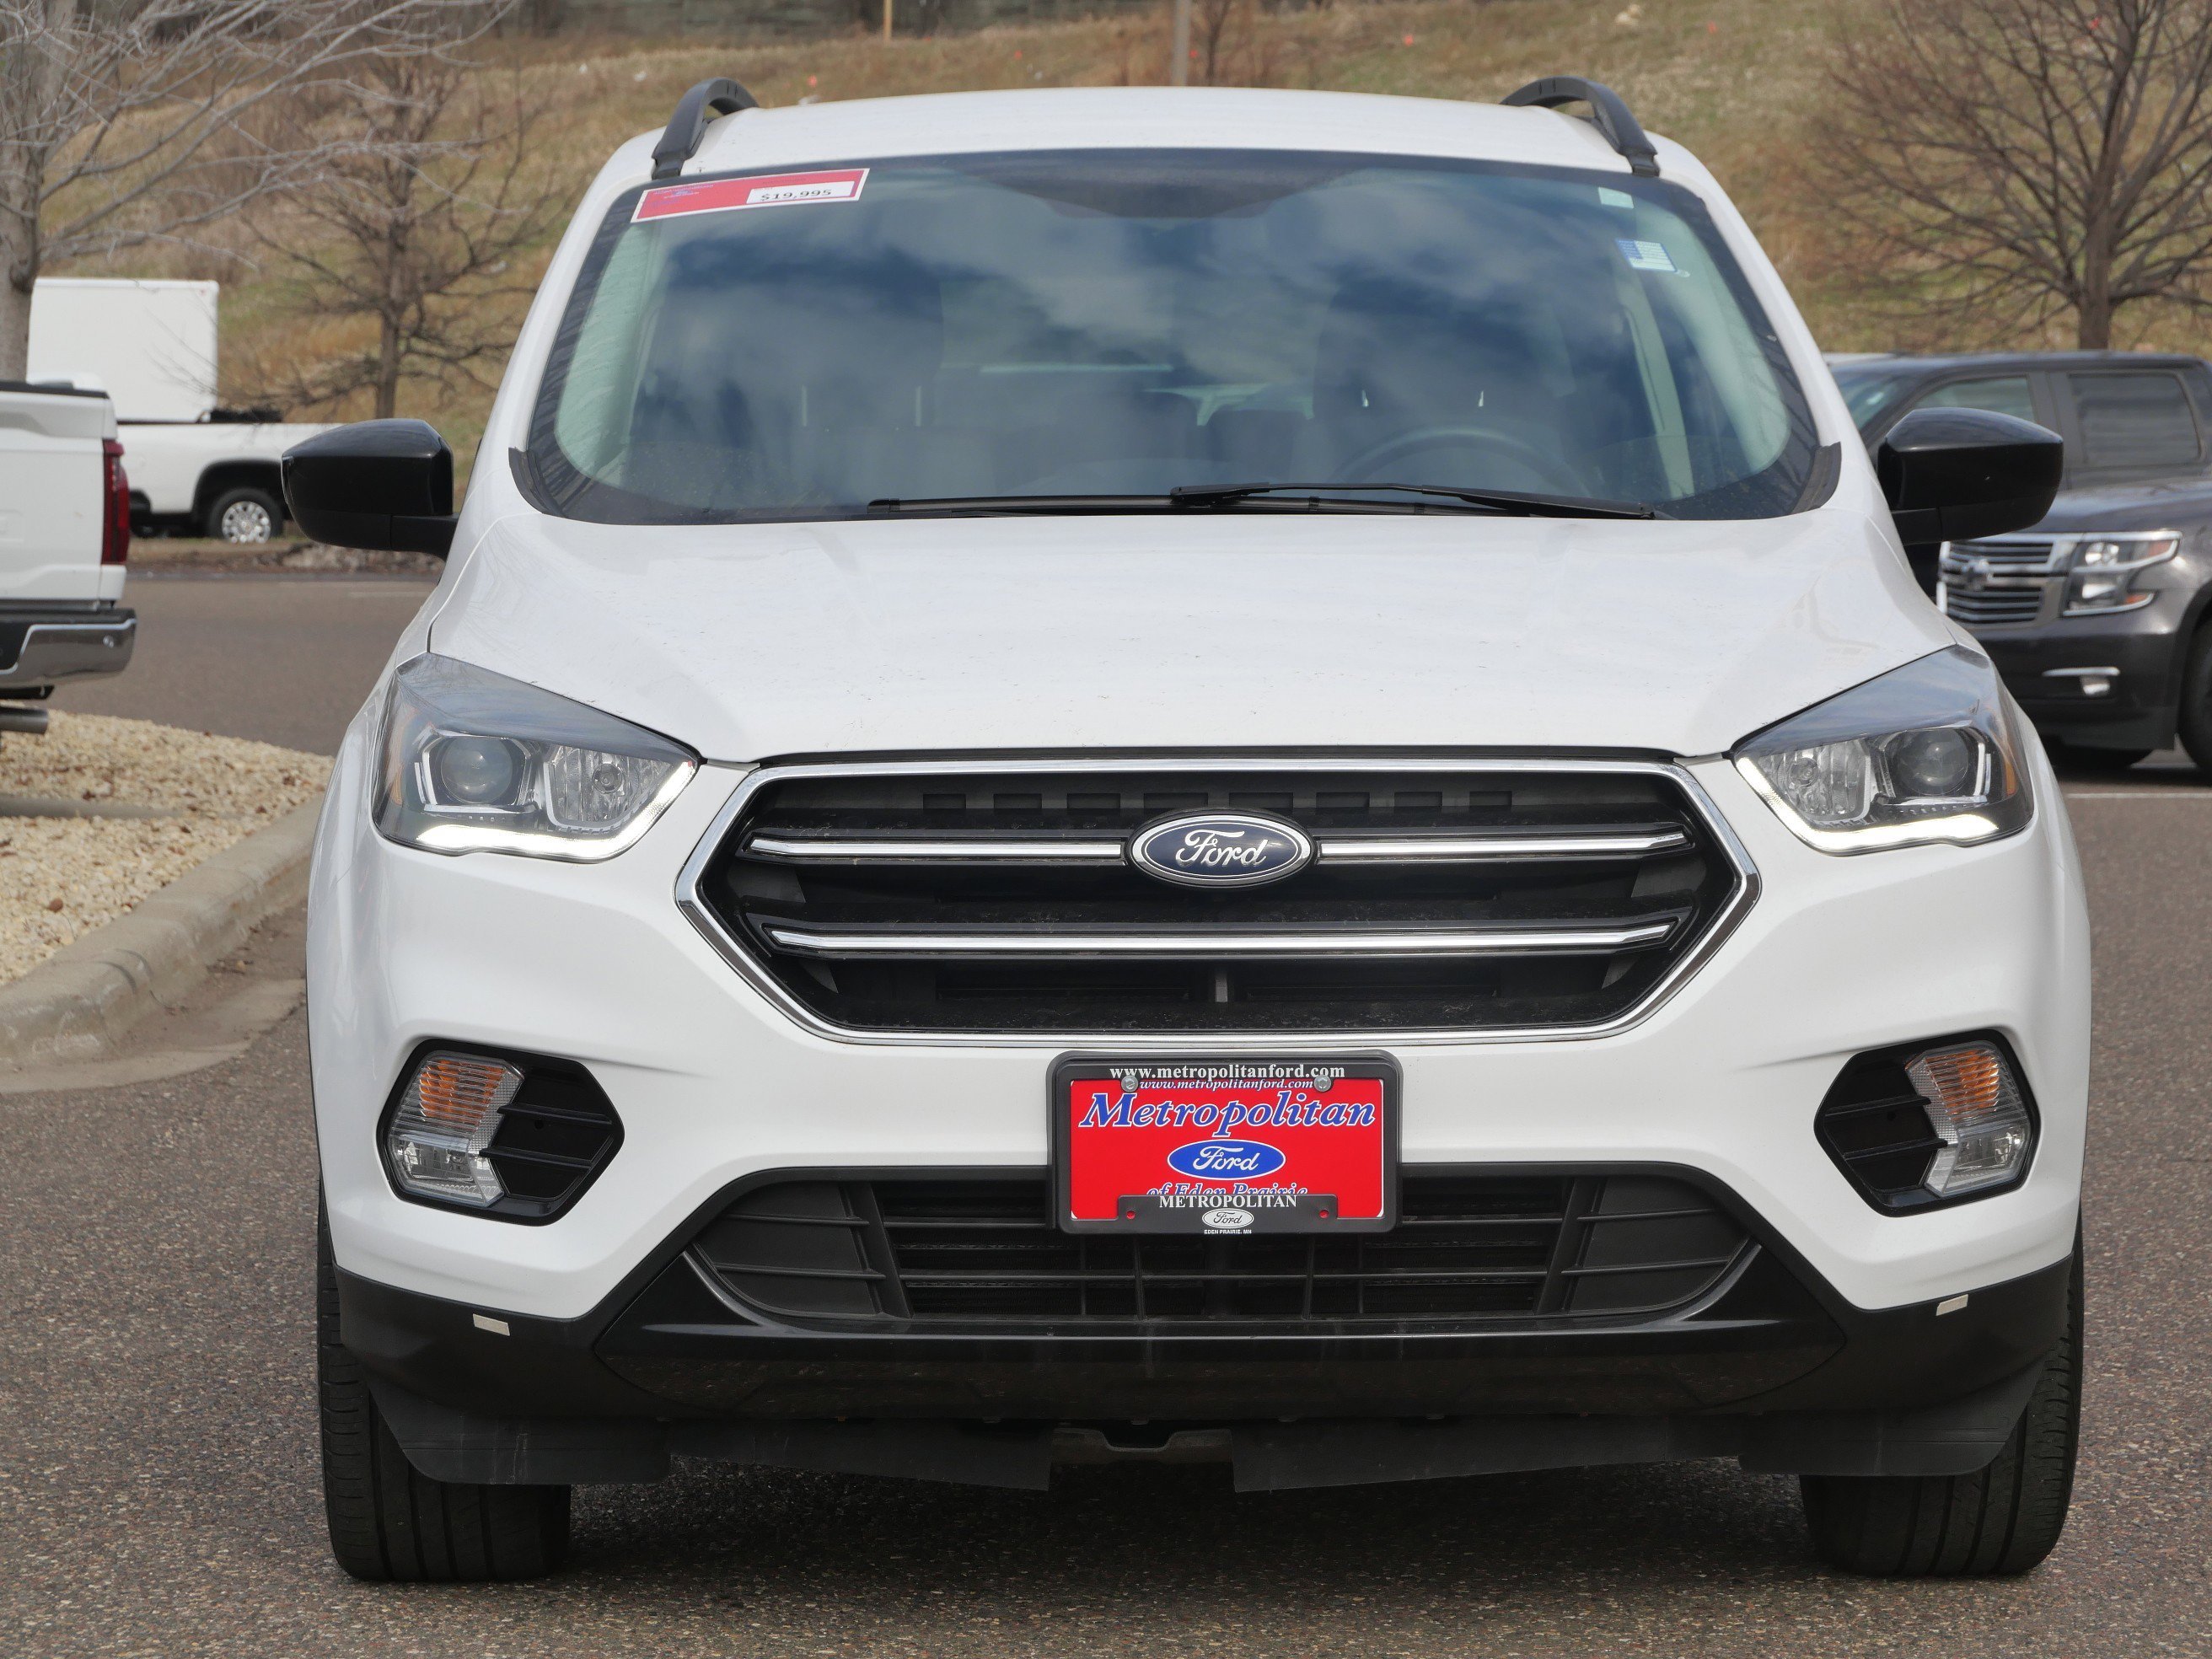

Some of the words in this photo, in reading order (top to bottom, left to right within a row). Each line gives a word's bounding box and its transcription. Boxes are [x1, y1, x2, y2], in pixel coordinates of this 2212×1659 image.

[760, 189, 833, 201] $19,995
[1175, 828, 1269, 867] Ford
[1109, 1064, 1346, 1081] www.metropolitanford.com
[1139, 1078, 1314, 1092] www.metropolitanford.com
[1078, 1091, 1376, 1138] Metropolitan
[1192, 1145, 1260, 1171] Ford
[1159, 1195, 1297, 1208] METROPOLITAN
[1213, 1211, 1243, 1224] Ford
